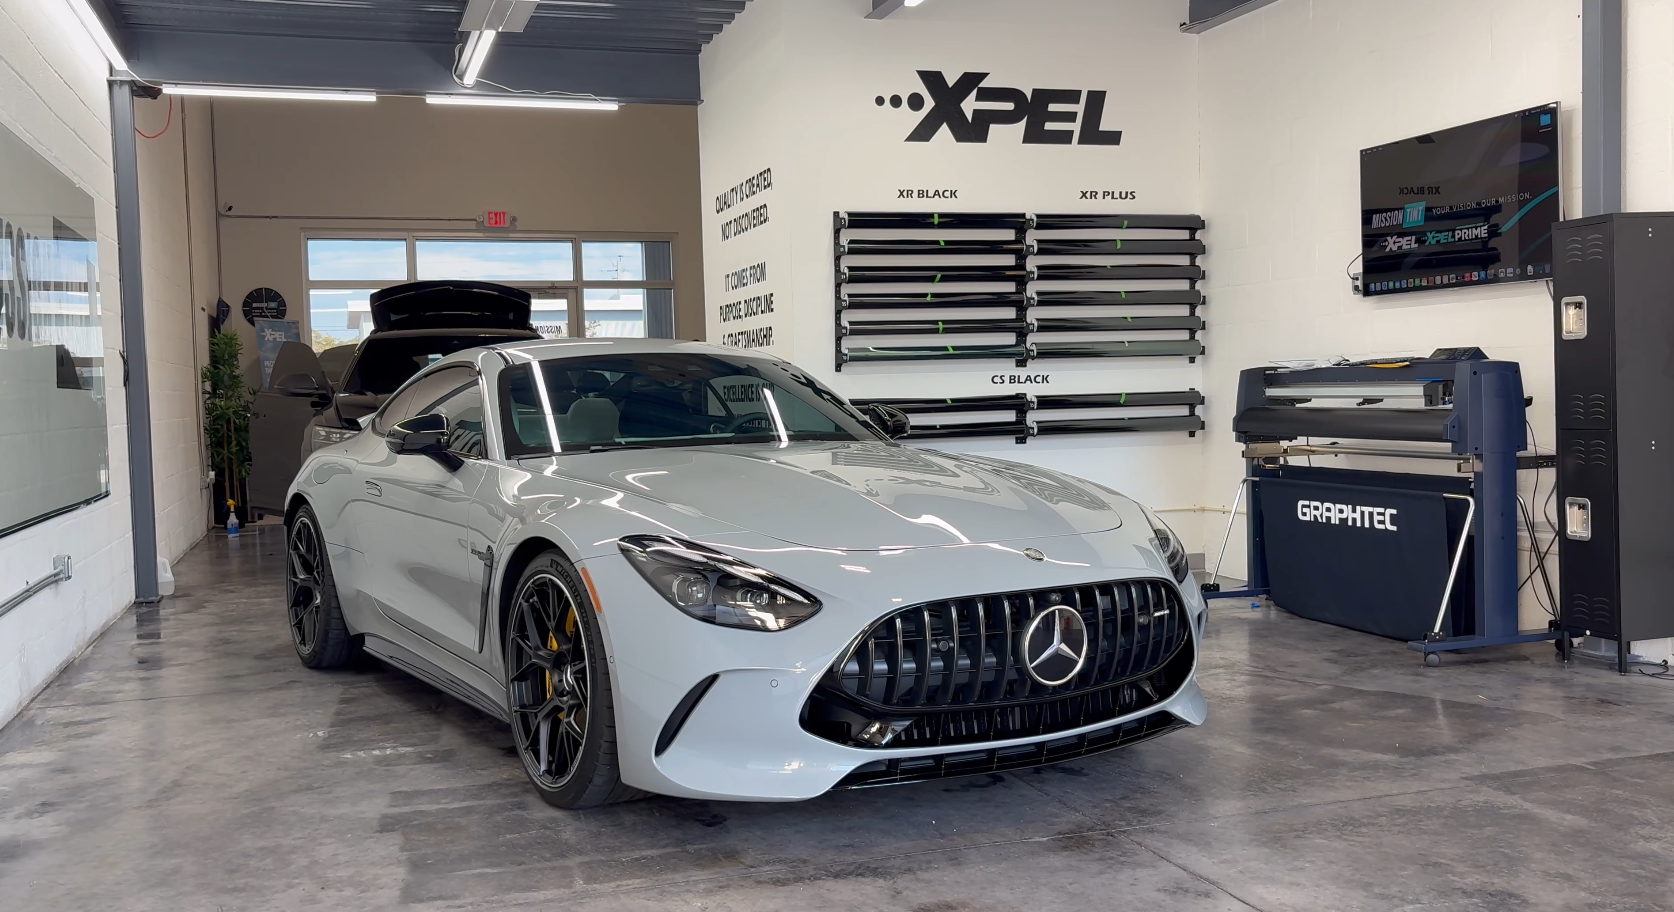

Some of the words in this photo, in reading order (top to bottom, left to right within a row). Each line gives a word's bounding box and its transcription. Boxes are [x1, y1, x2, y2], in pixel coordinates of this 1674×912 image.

[904, 69, 1122, 146] XPEL
[715, 184, 738, 215] QUALITY
[739, 182, 744, 203] IS
[745, 167, 773, 199] CREATED,
[897, 189, 914, 199] XR
[917, 189, 958, 199] BLACK
[1079, 190, 1098, 200] XR
[1102, 190, 1136, 200] PLUS
[1432, 206, 1450, 215] YOUR
[1453, 201, 1479, 212] VISION.
[1481, 198, 1496, 207] OUR
[1499, 191, 1533, 203] MISSION.
[487, 211, 506, 226] EXIT
[721, 220, 732, 242] NOT
[733, 203, 769, 238] DISCOVERED.
[1371, 209, 1404, 229] MISSION
[1406, 206, 1424, 223] TINT
[1385, 235, 1419, 252] XPEL
[1455, 225, 1489, 241] PRIME
[724, 273, 730, 292] IT
[730, 267, 748, 291] COMES
[749, 261, 767, 285] FROM
[719, 301, 743, 324] PURPOSE,
[744, 292, 774, 318] DISCIPLINE
[264, 328, 287, 342] XPEL
[727, 326, 775, 349] CRAFTSMANSHIP.
[991, 374, 1006, 385] CS
[1009, 374, 1050, 385] BLACK
[723, 383, 754, 402] EXCELLENCE
[755, 383, 761, 402] IS
[1297, 500, 1397, 531] GRAPHTEC
[556, 565, 582, 603] MICHELIN
